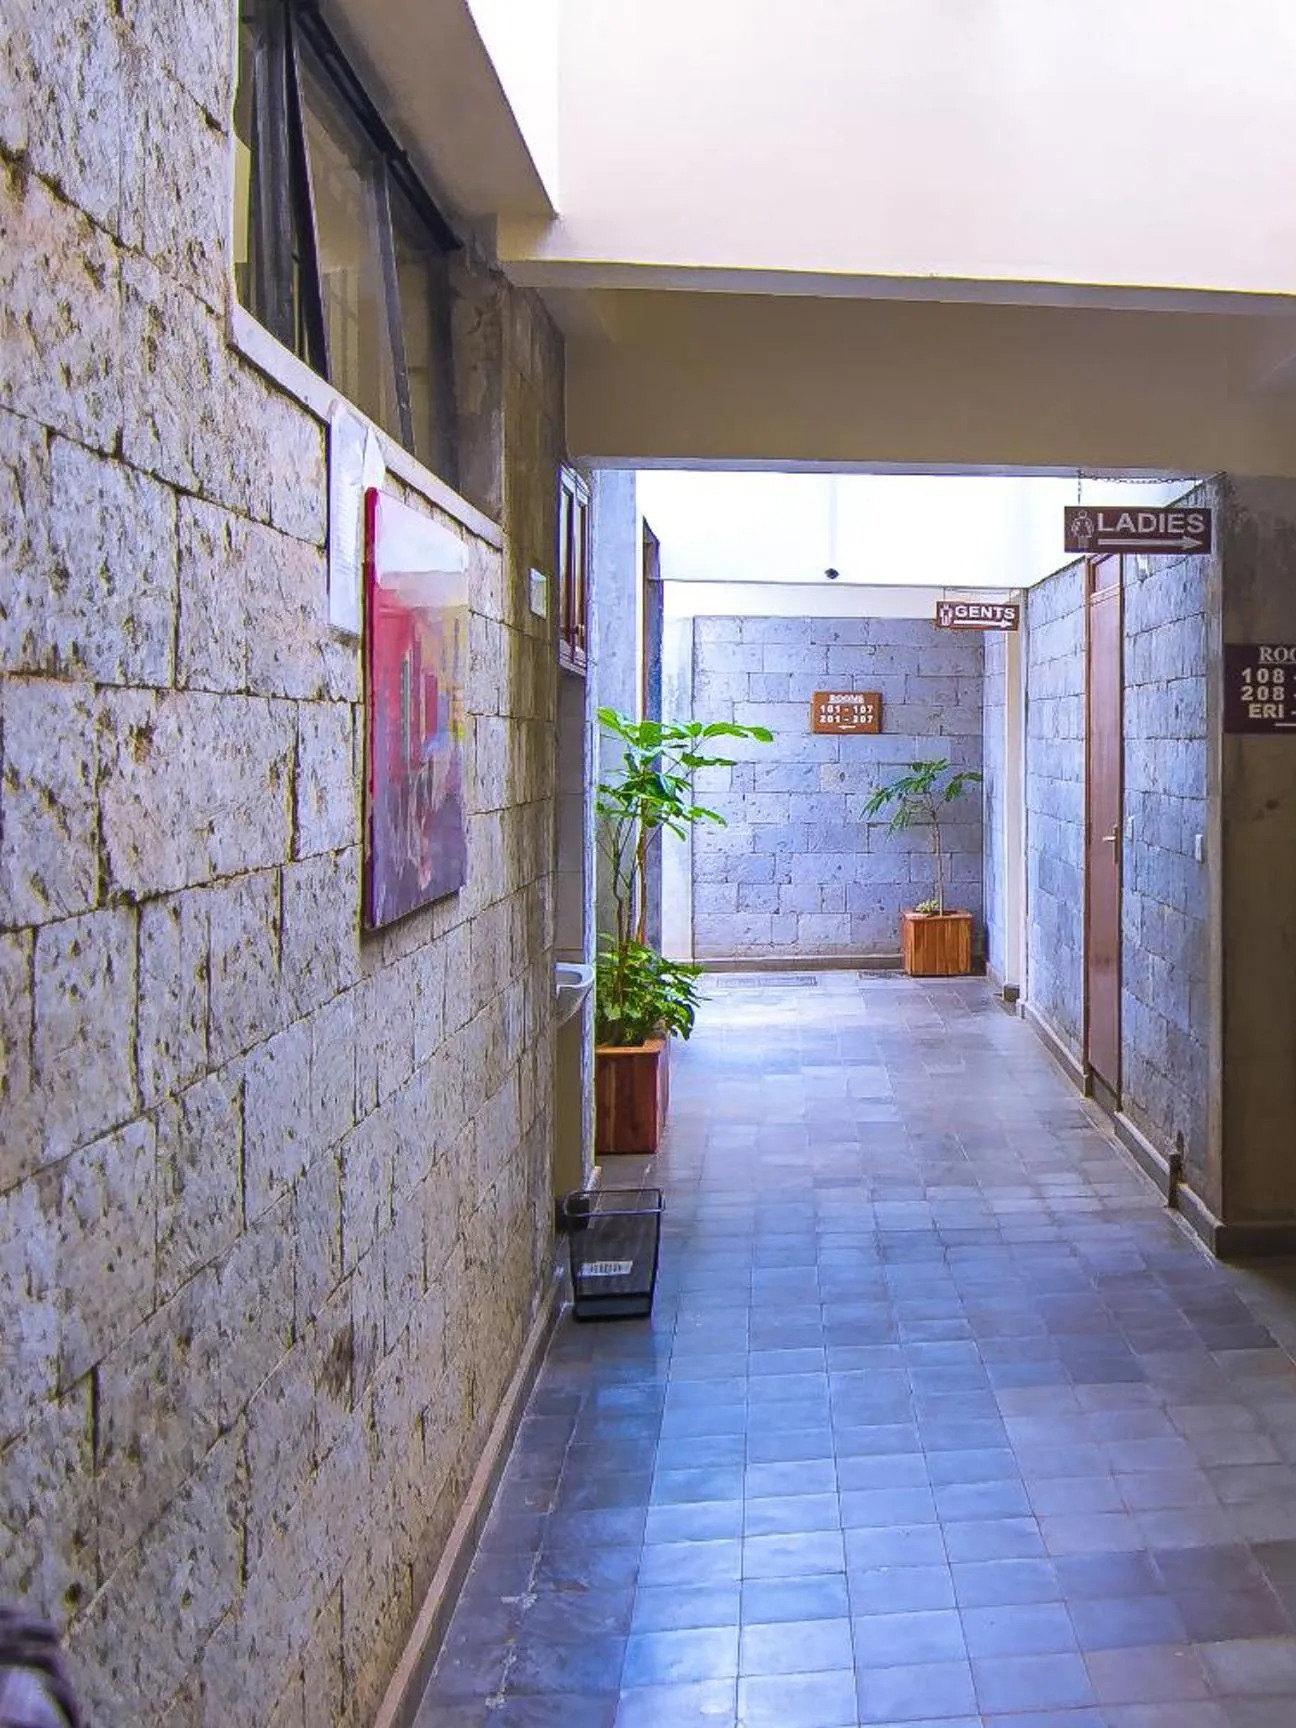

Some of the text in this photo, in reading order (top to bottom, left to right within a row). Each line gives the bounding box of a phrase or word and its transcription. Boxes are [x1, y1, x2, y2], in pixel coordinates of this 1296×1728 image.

[1097, 512, 1205, 533] LADIES
[955, 605, 1015, 619] GENTS
[1241, 668, 1285, 683] 108
[1241, 686, 1285, 700] 208
[1248, 703, 1284, 718] ERI
